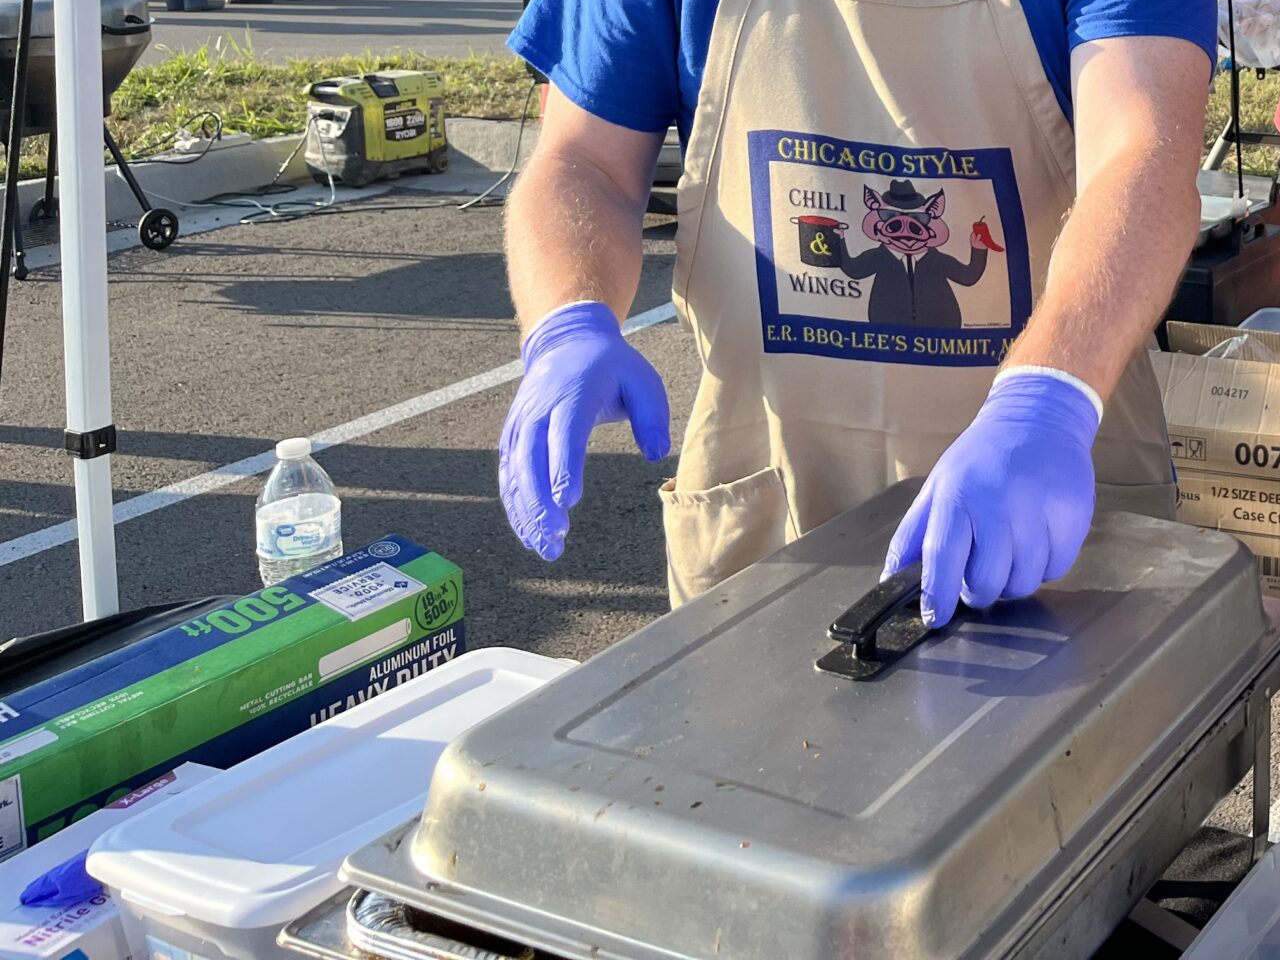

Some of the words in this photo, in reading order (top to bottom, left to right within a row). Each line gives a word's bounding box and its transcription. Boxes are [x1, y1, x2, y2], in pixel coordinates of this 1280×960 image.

[778, 137, 895, 173] CHICAGO
[902, 151, 979, 177] STYLE
[788, 188, 847, 212] CHILI
[810, 232, 832, 256] &
[788, 272, 862, 299] WINGS
[767, 324, 797, 342] E.R.
[803, 326, 908, 352] BBQ-LEE'S
[913, 336, 996, 357] SUMMIT,
[1211, 386, 1250, 400] 004217
[1211, 486, 1229, 500] 1/2
[1231, 488, 1257, 502] SIZE
[1233, 507, 1265, 523] Case
[369, 640, 430, 682] ALUMINUM
[432, 628, 457, 651] FOIL
[240, 697, 264, 712] METAL
[265, 682, 297, 700] CUTTING
[298, 673, 314, 685] BAR
[249, 702, 268, 715] 100%
[269, 680, 314, 706] RECYCLABLE
[119, 777, 169, 807] X-Large
[23, 906, 91, 948] Nitrile
